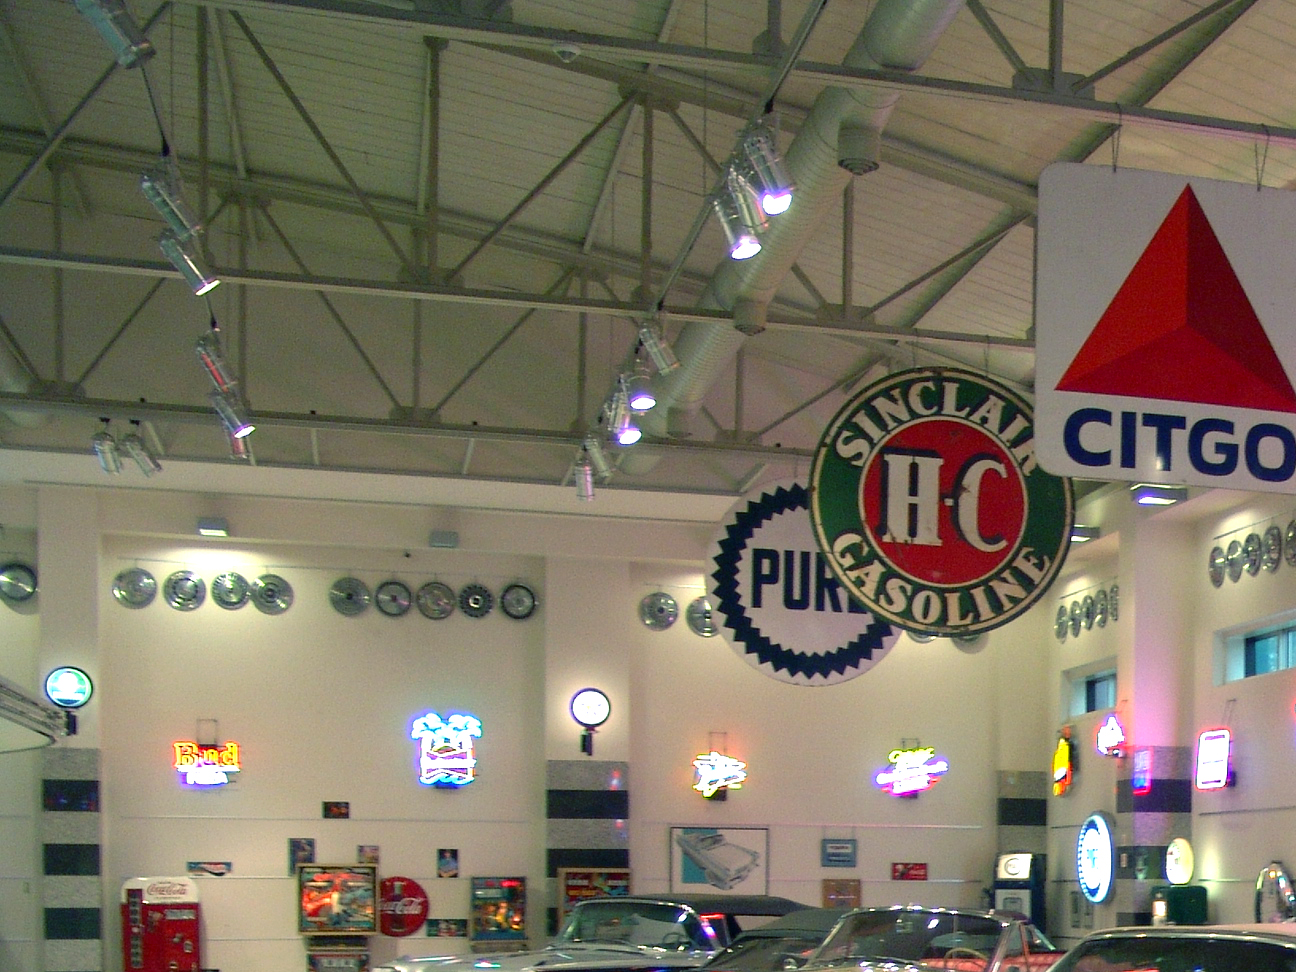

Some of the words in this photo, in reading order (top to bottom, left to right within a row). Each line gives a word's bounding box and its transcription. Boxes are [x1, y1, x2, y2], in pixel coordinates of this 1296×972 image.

[880, 450, 1010, 553] H-C
[832, 545, 1050, 626] GASOLINE
[173, 741, 240, 768] Bud
